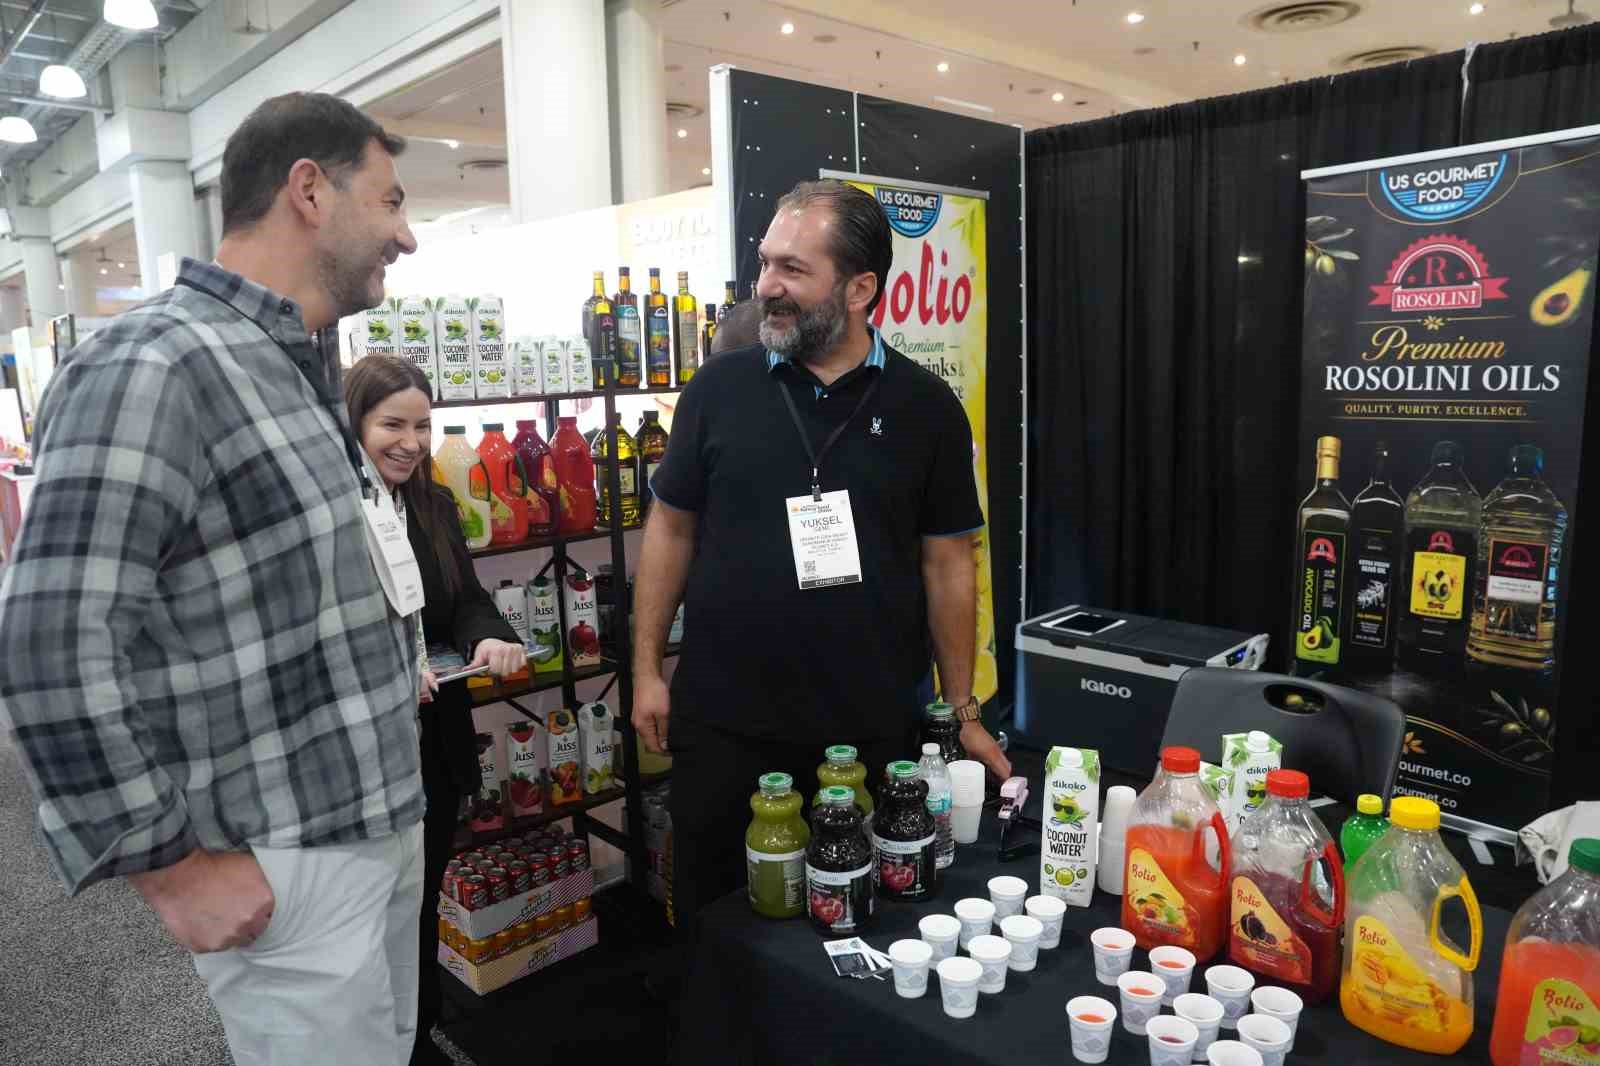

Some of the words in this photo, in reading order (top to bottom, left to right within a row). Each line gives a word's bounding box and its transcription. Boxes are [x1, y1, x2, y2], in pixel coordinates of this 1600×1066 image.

[1389, 174, 1409, 190] US
[1413, 161, 1499, 187] GOURMET
[880, 190, 894, 205] US
[894, 191, 938, 209] GOURMET
[1418, 186, 1463, 203] FOOD
[898, 207, 922, 222] FOOD
[1425, 256, 1447, 285] R
[1396, 289, 1477, 309] ROSOLINI
[892, 332, 945, 354] Premium
[1362, 326, 1505, 361] Premium
[1325, 365, 1472, 391] ROSOLINI
[1482, 365, 1560, 391] OILS
[1344, 404, 1394, 415] QUALITY.
[1398, 405, 1442, 416] PURITY.
[1446, 405, 1528, 417] EXCELLENCE.
[800, 515, 842, 528] YUKSEL
[1304, 568, 1314, 613] AVOCADO
[535, 606, 554, 616] Juss
[573, 600, 594, 611] Juss
[1303, 614, 1312, 630] OIL
[1080, 678, 1132, 699] IGLOO
[557, 742, 577, 752] Juss
[514, 751, 535, 762] Juss
[1399, 761, 1471, 786] ourmet.co
[1052, 780, 1087, 791] dikoko
[1047, 829, 1088, 845] COCONUT
[1050, 841, 1082, 857] WATER
